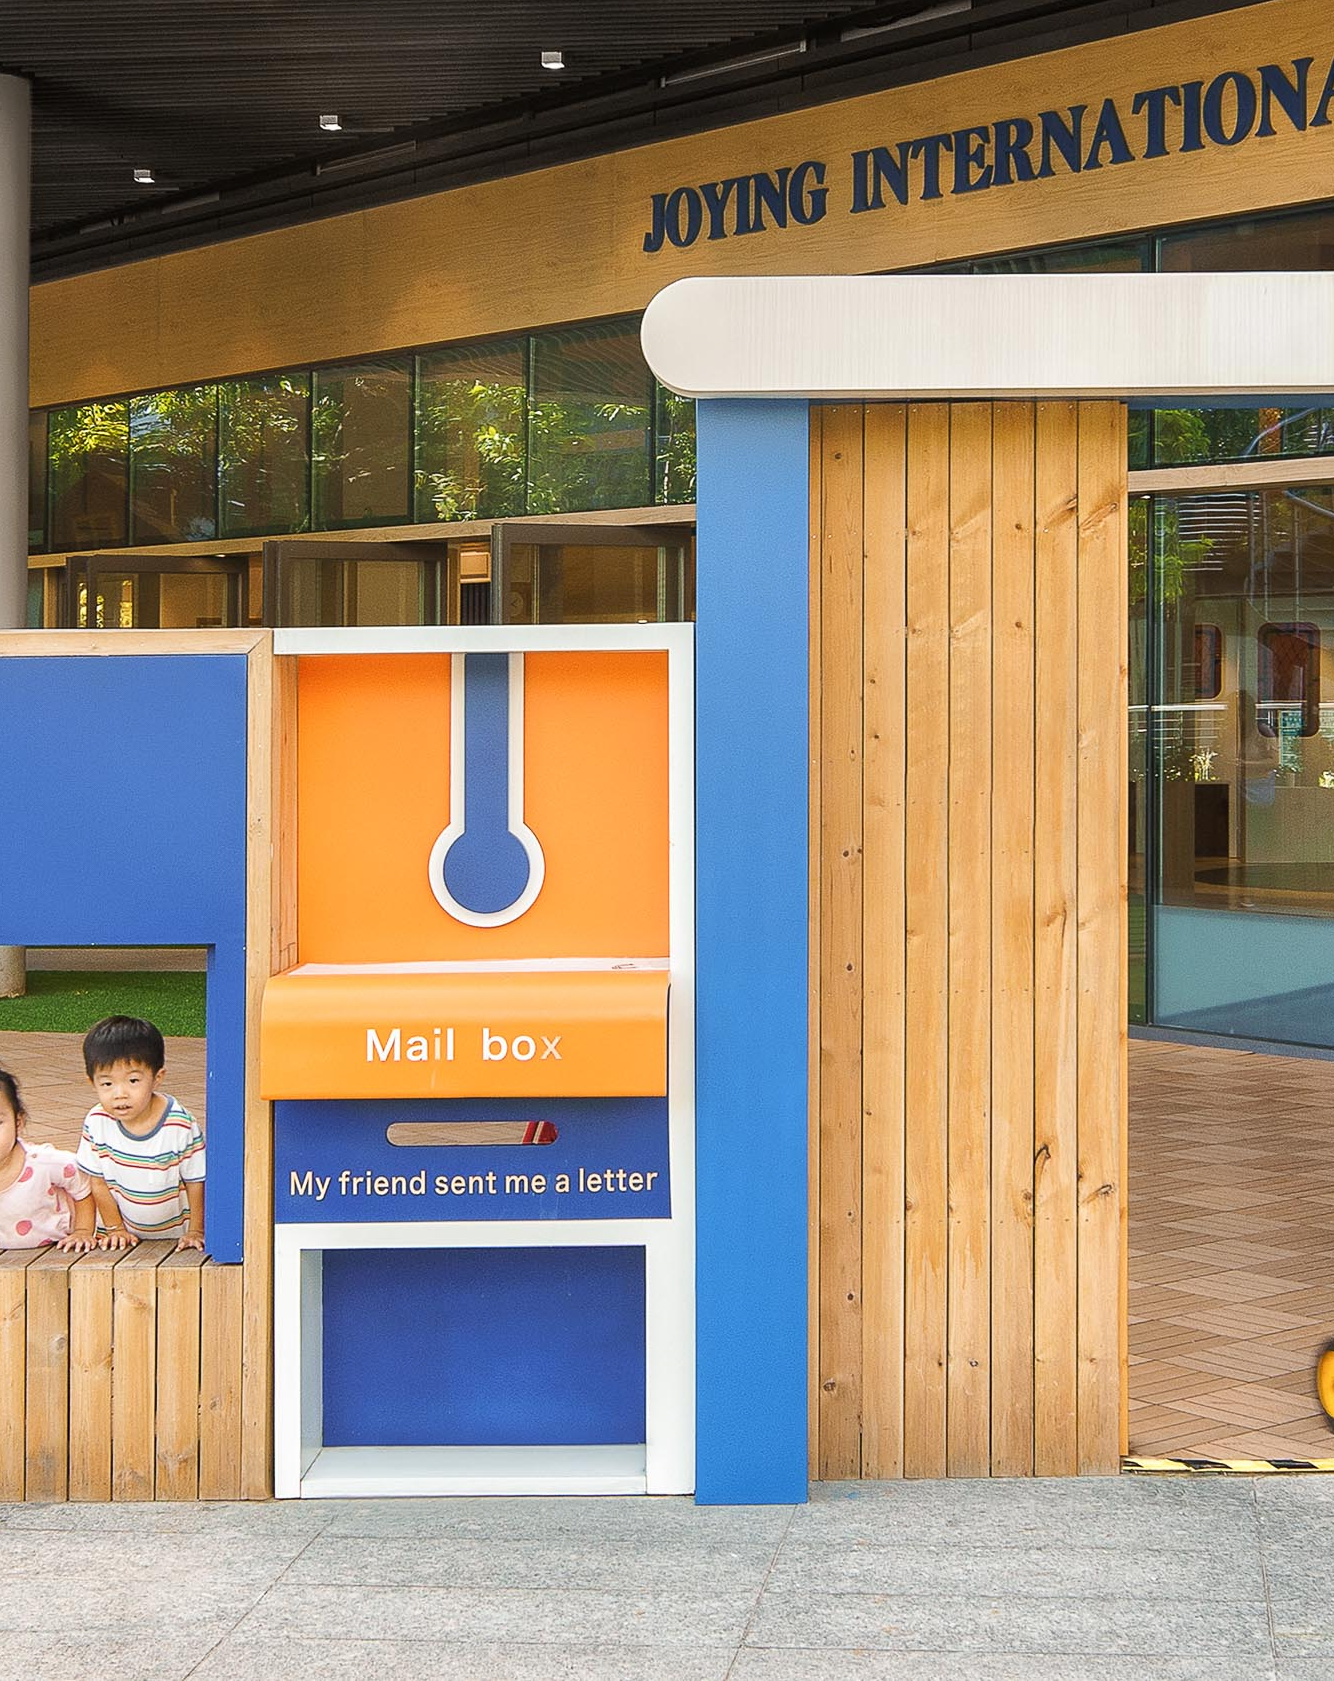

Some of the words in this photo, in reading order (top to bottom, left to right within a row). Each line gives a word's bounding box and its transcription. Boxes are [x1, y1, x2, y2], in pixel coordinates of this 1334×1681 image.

[642, 160, 829, 253] JOYING
[365, 1027, 455, 1063] Mail
[481, 1027, 563, 1063] box
[289, 1170, 331, 1202] My
[338, 1169, 427, 1196] friend
[433, 1170, 497, 1196] sent
[504, 1174, 548, 1195] me
[554, 1173, 571, 1194] a
[578, 1166, 659, 1194] letter
